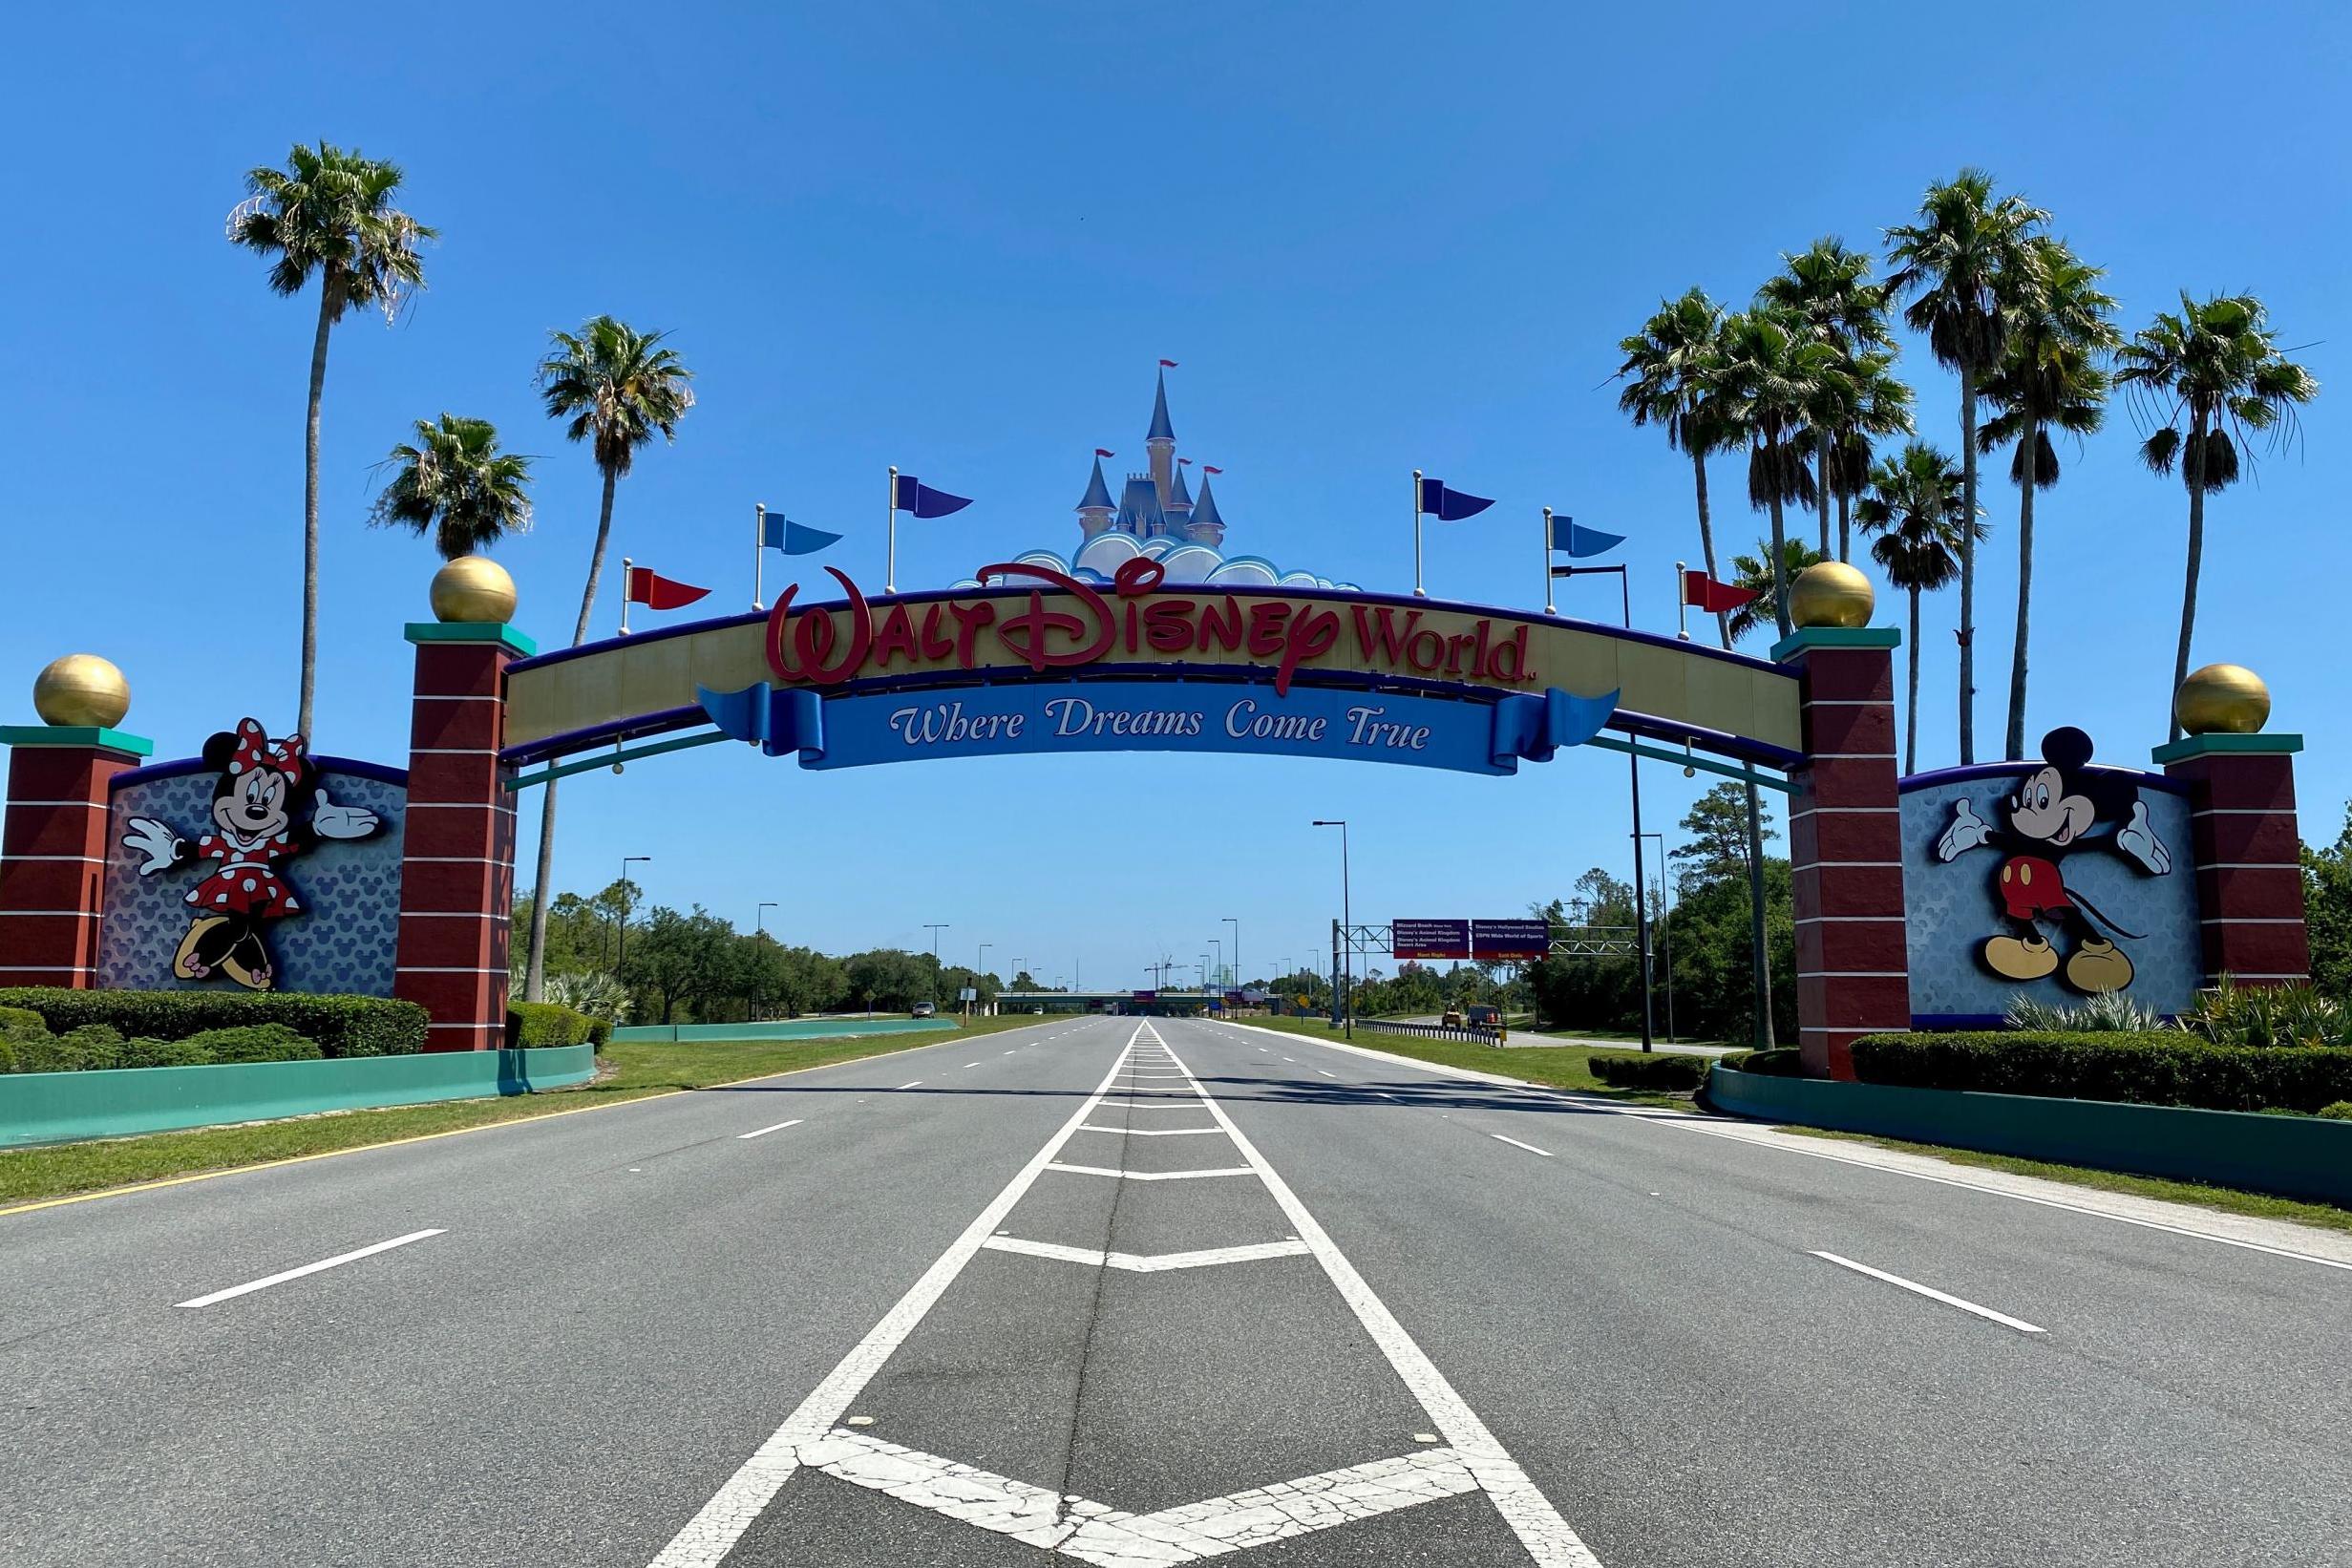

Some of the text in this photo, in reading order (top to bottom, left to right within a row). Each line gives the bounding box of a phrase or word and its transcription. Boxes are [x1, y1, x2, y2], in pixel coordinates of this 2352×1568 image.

[889, 698, 1431, 750] Where Dreams Come True
